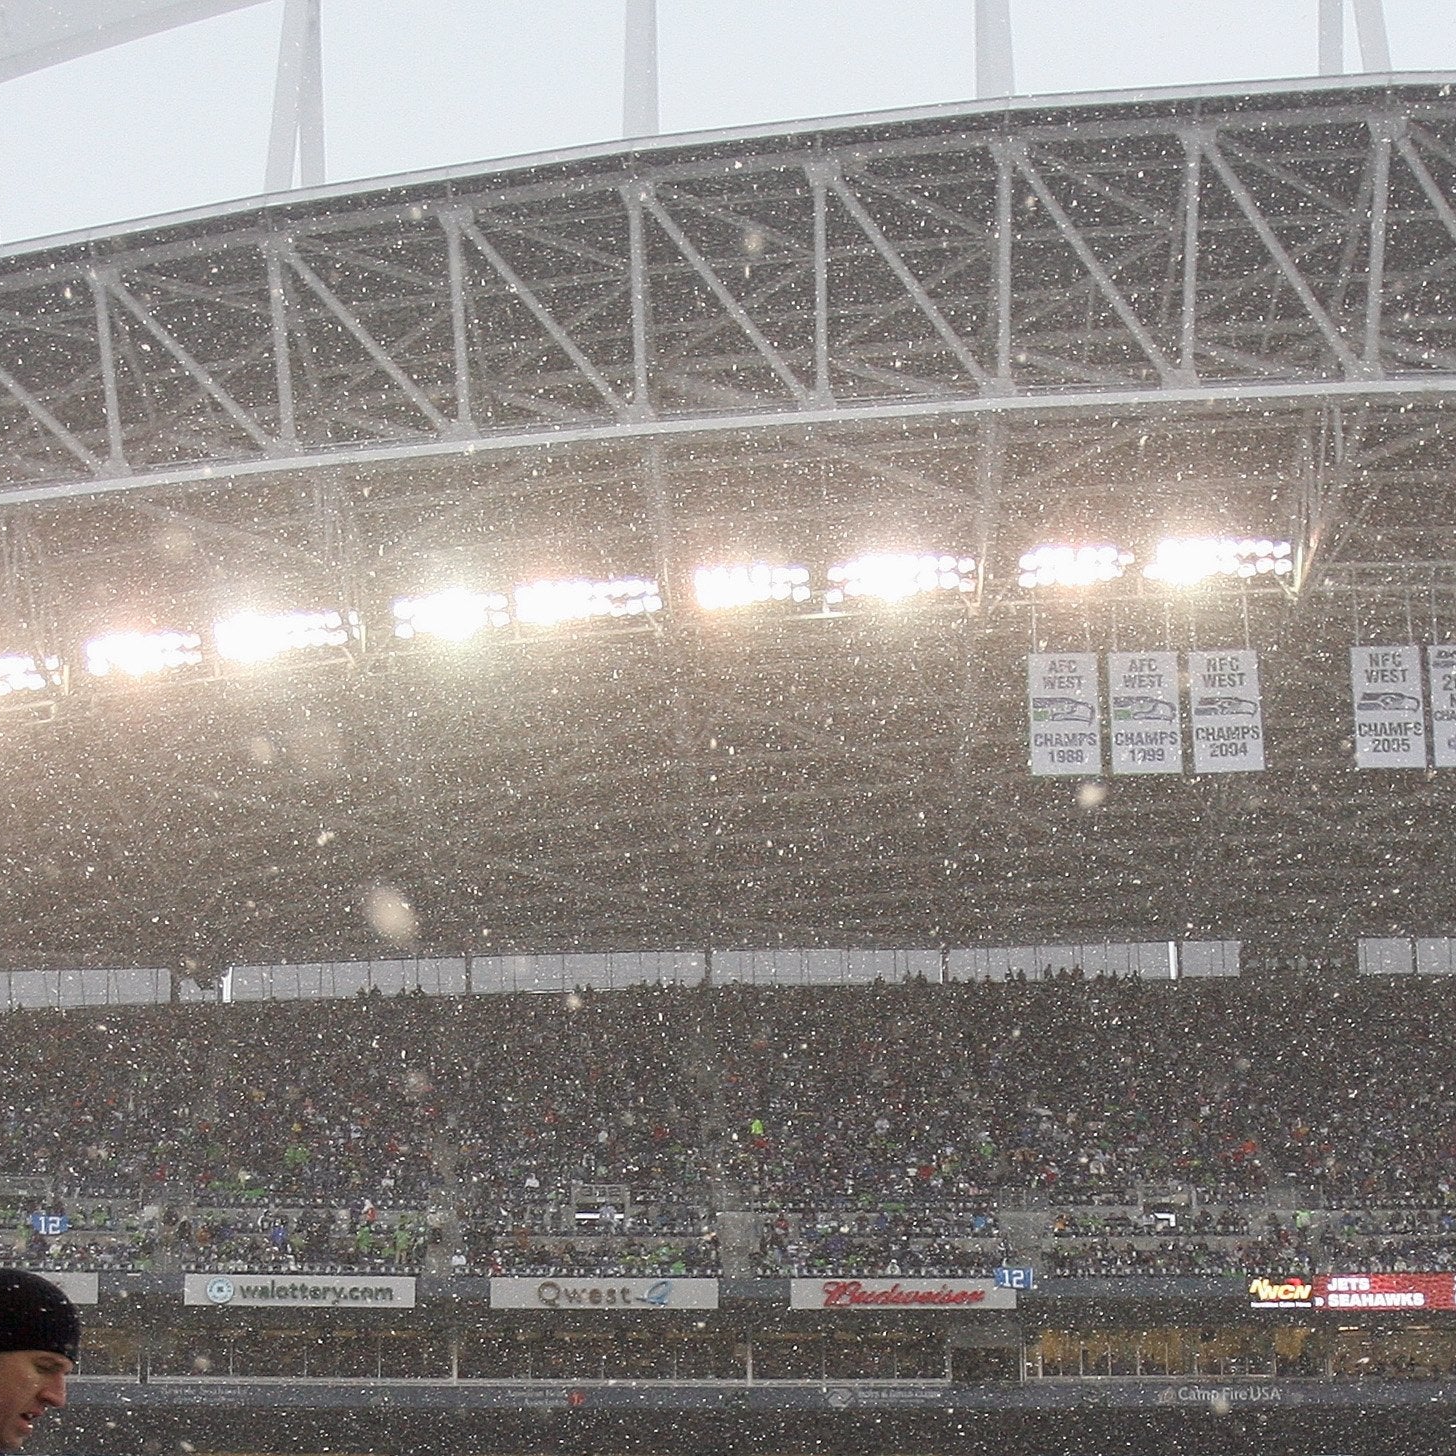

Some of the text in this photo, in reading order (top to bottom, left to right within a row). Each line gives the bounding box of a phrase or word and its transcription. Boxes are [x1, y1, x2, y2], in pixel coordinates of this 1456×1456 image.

[1048, 660, 1077, 673] AFC
[1129, 658, 1158, 672] AFC
[1206, 658, 1239, 672] NFC
[1369, 653, 1402, 667] NFC
[1043, 674, 1084, 689] WEST
[1123, 674, 1164, 688] WEST
[1202, 672, 1246, 688] WEST
[1365, 668, 1409, 683] WEST
[1196, 725, 1261, 741] CHAMPS
[1358, 722, 1423, 737] CHAMPS
[1034, 732, 1097, 747] CHAMPS
[1114, 731, 1178, 746] CHAMPS
[1372, 738, 1411, 752] 2005
[1210, 742, 1249, 757] 2004
[38, 1216, 61, 1235] 12
[1002, 1270, 1025, 1287] 12
[1327, 1277, 1371, 1292] JETS
[240, 1280, 394, 1305] walottery.com
[538, 1280, 631, 1308] Qwest
[823, 1280, 986, 1308] Budweiser
[1327, 1292, 1425, 1308] SEAHAWKS
[1178, 1385, 1282, 1402] Camp Fire USA
